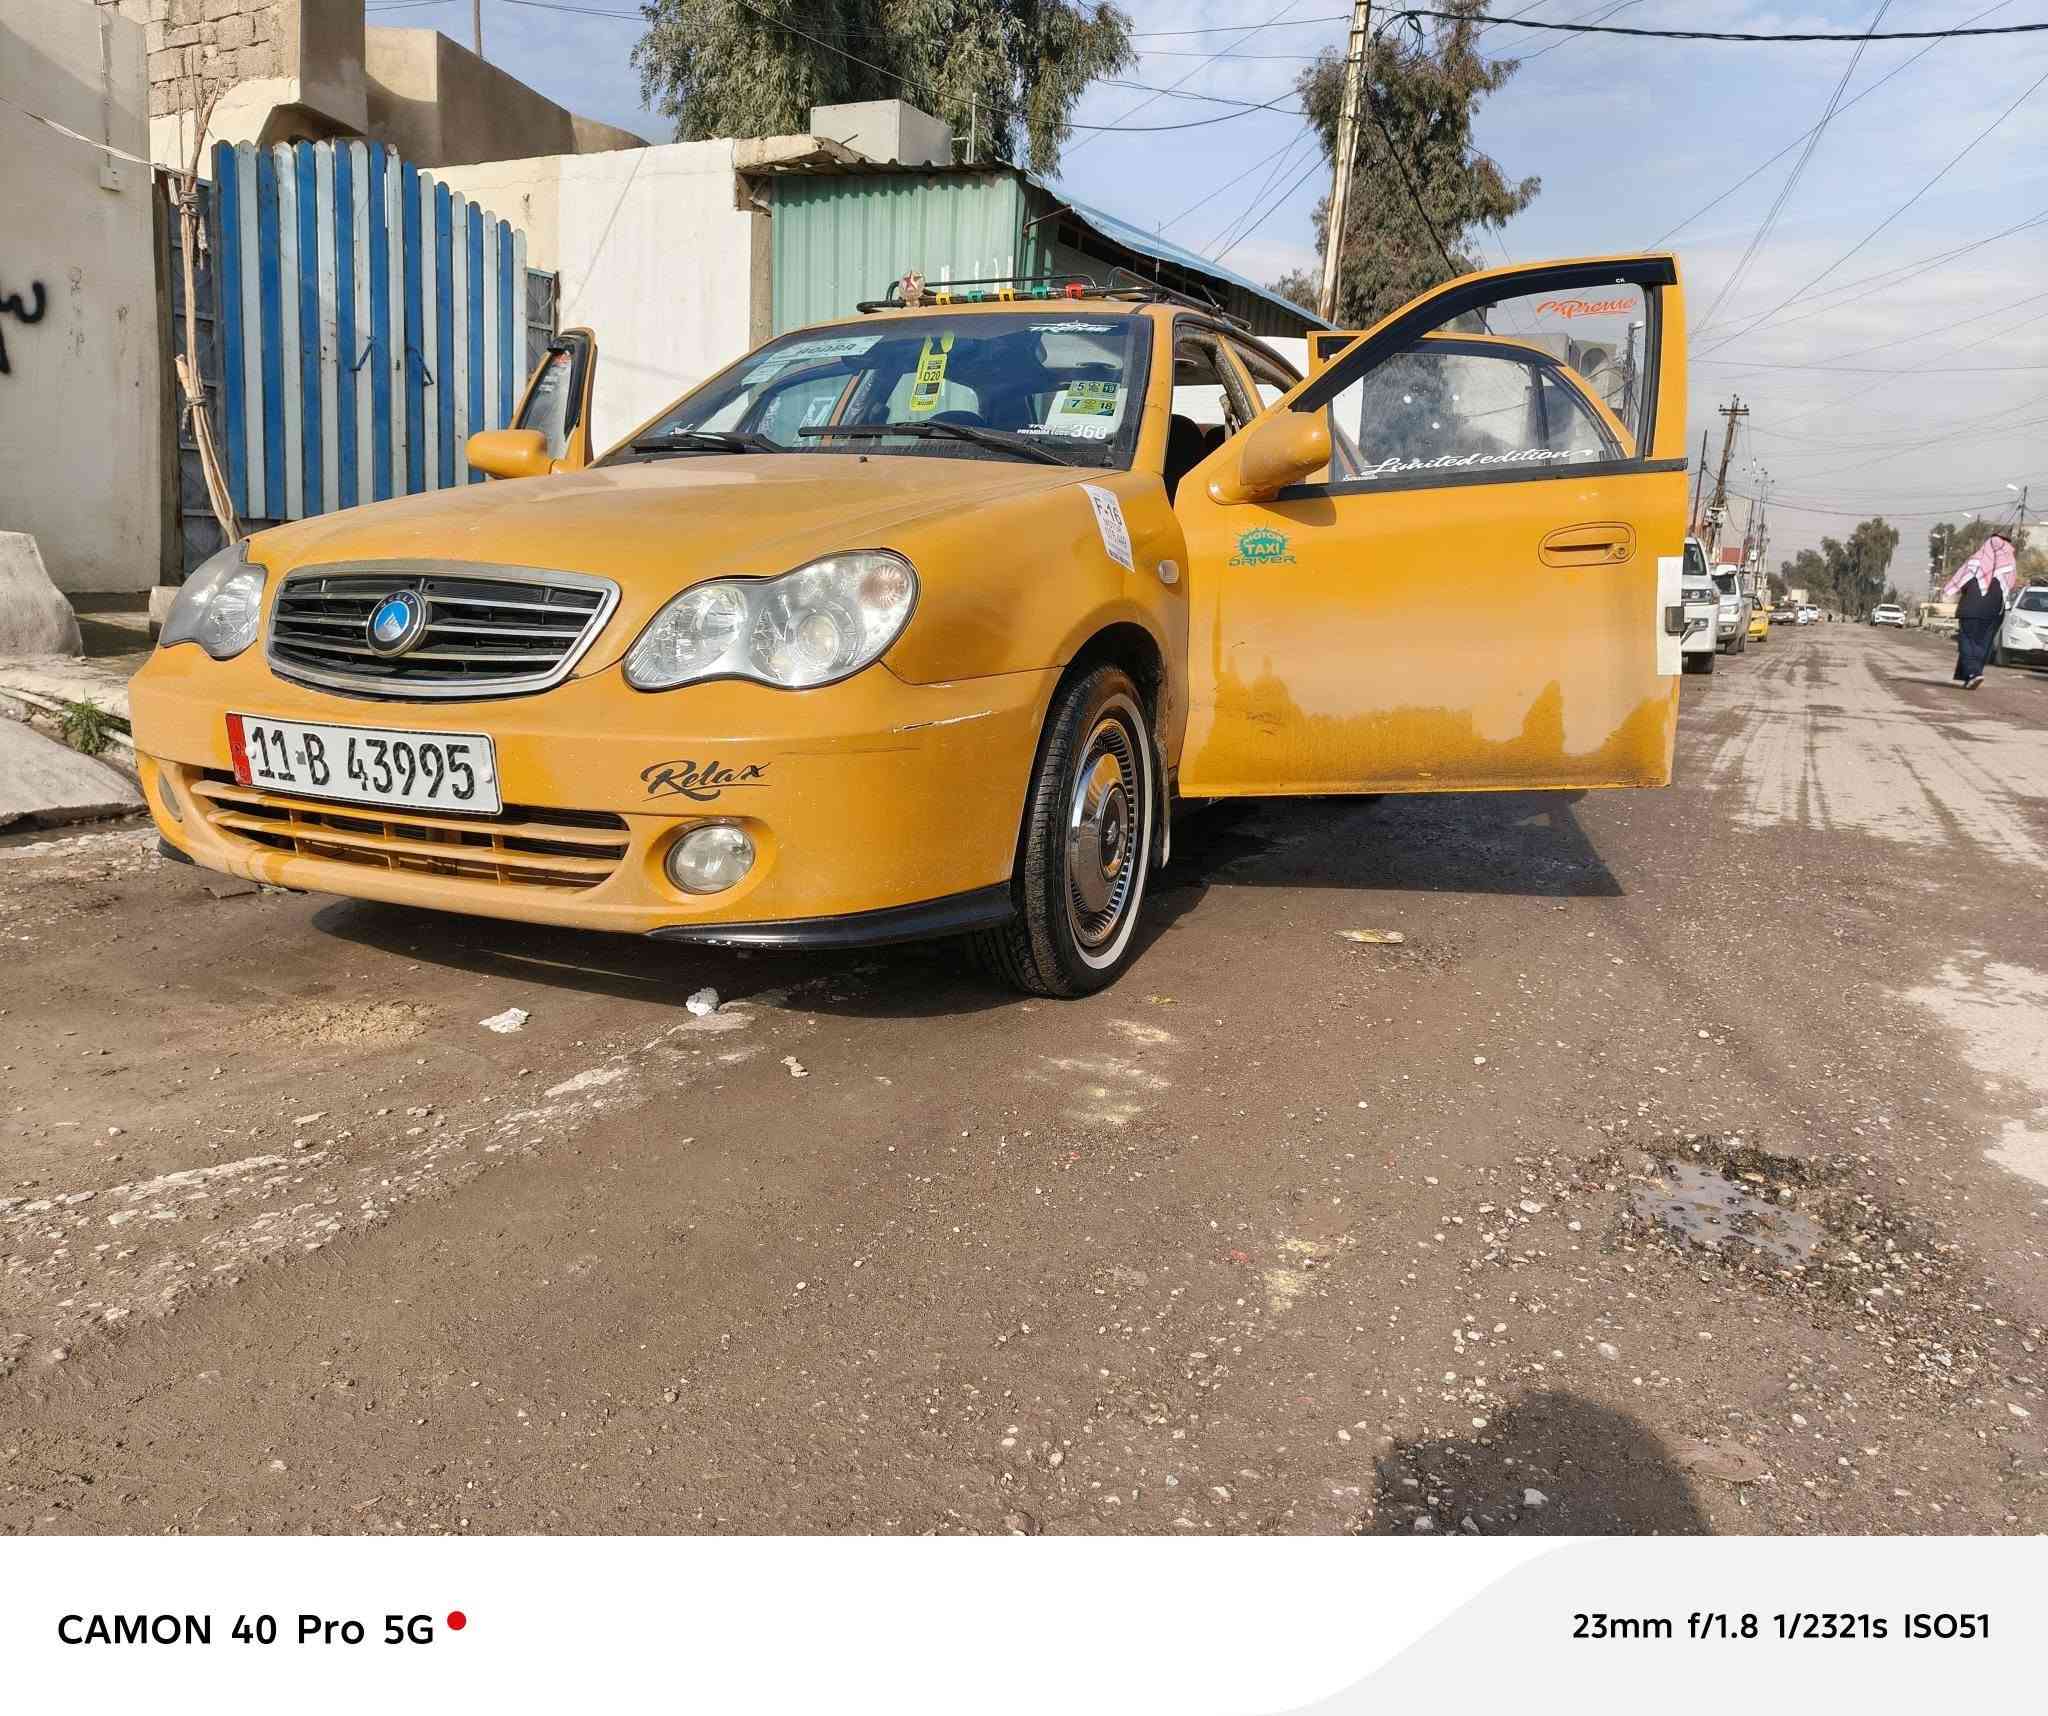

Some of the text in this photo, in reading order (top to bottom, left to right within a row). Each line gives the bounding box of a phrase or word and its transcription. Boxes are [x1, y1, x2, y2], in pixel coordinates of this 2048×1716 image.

[924, 371, 941, 382] D20
[1077, 383, 1085, 391] 5
[1071, 399, 1113, 410] 7 18
[1069, 424, 1107, 440] 360
[1361, 448, 1594, 477] Limited edition
[1245, 543, 1281, 555] TAXI
[1228, 554, 1298, 568] DRIVER
[347, 736, 476, 801] 43995
[639, 759, 773, 802] Relax
